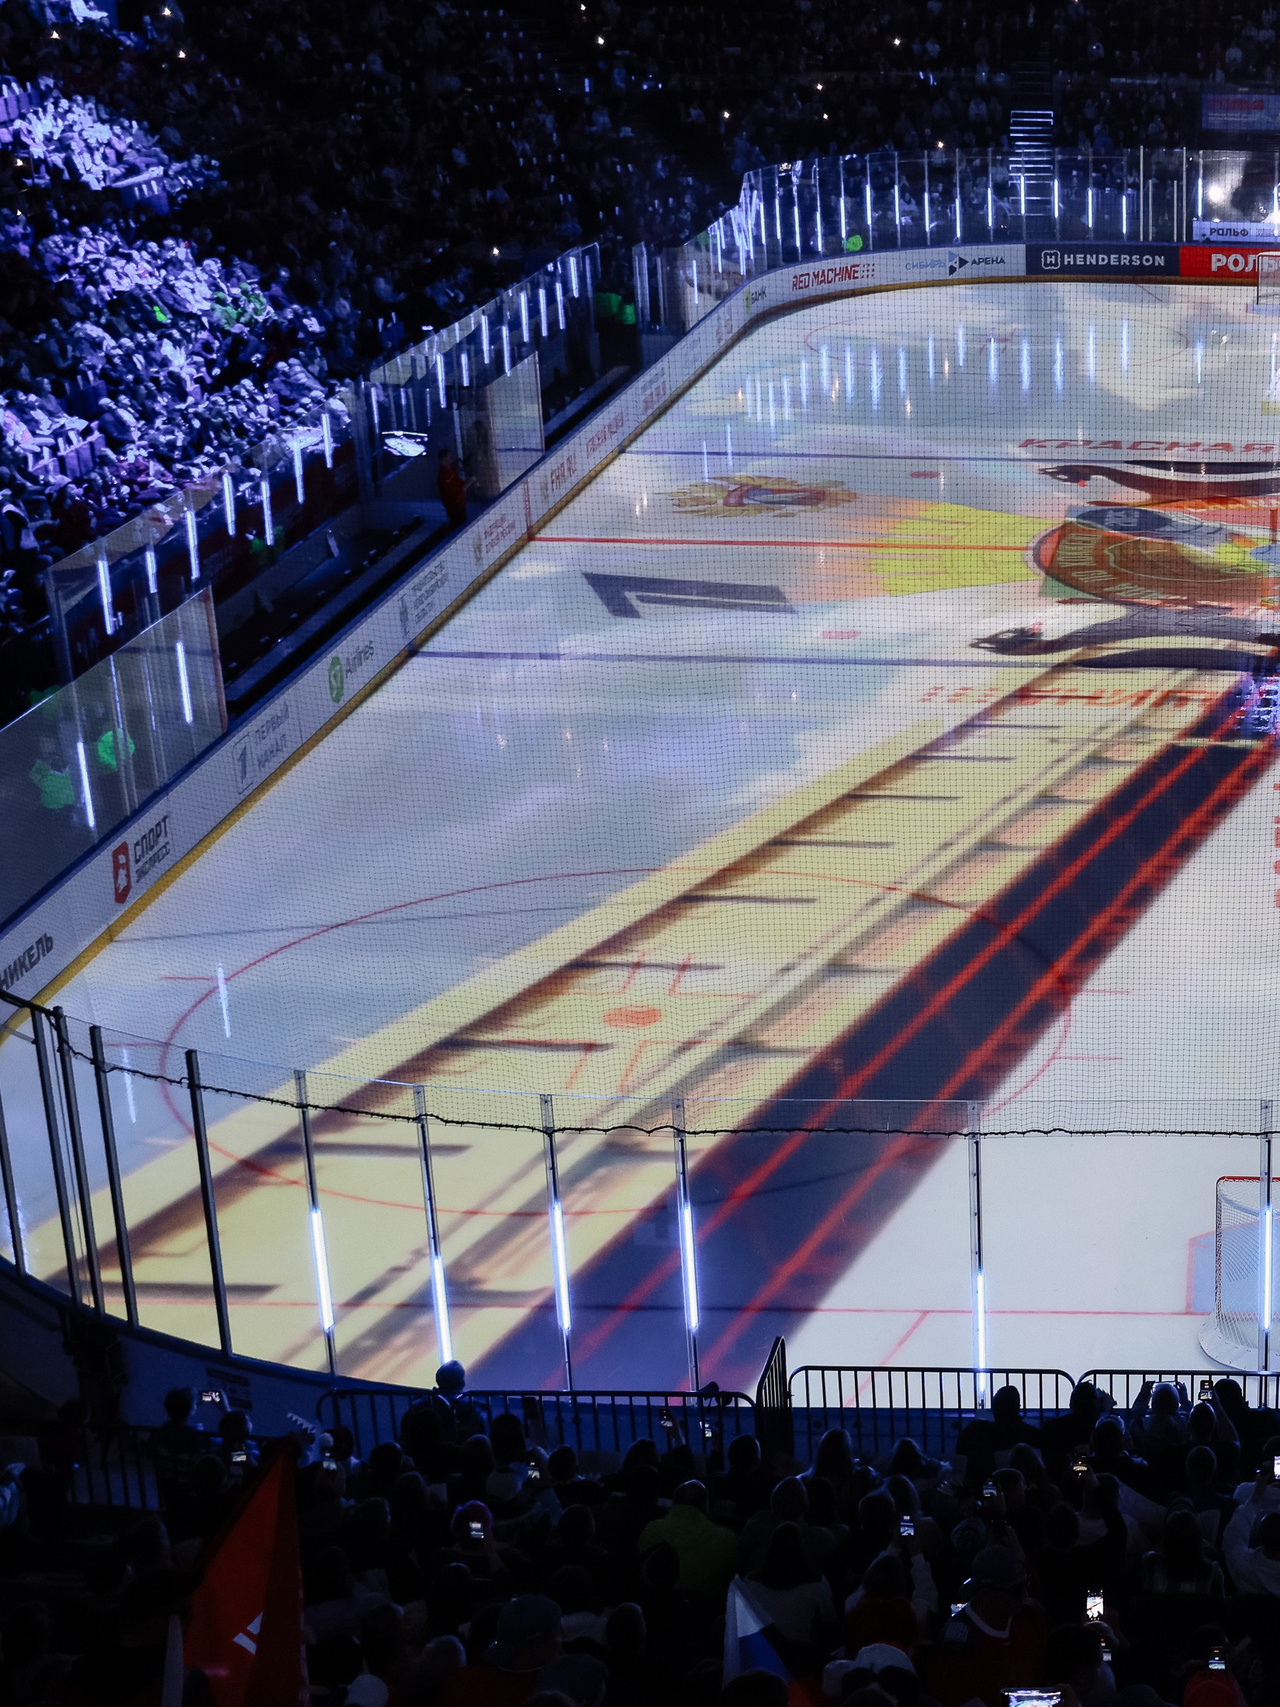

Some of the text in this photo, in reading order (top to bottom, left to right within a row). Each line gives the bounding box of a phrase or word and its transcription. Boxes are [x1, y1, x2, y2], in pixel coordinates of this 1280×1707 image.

[1209, 227, 1249, 238] РОЛЬФ
[970, 256, 1006, 266] АРЕНА
[1063, 253, 1166, 267] HENDERSON
[792, 263, 862, 292] RED MACHINE
[133, 814, 169, 865] СПОРТ
